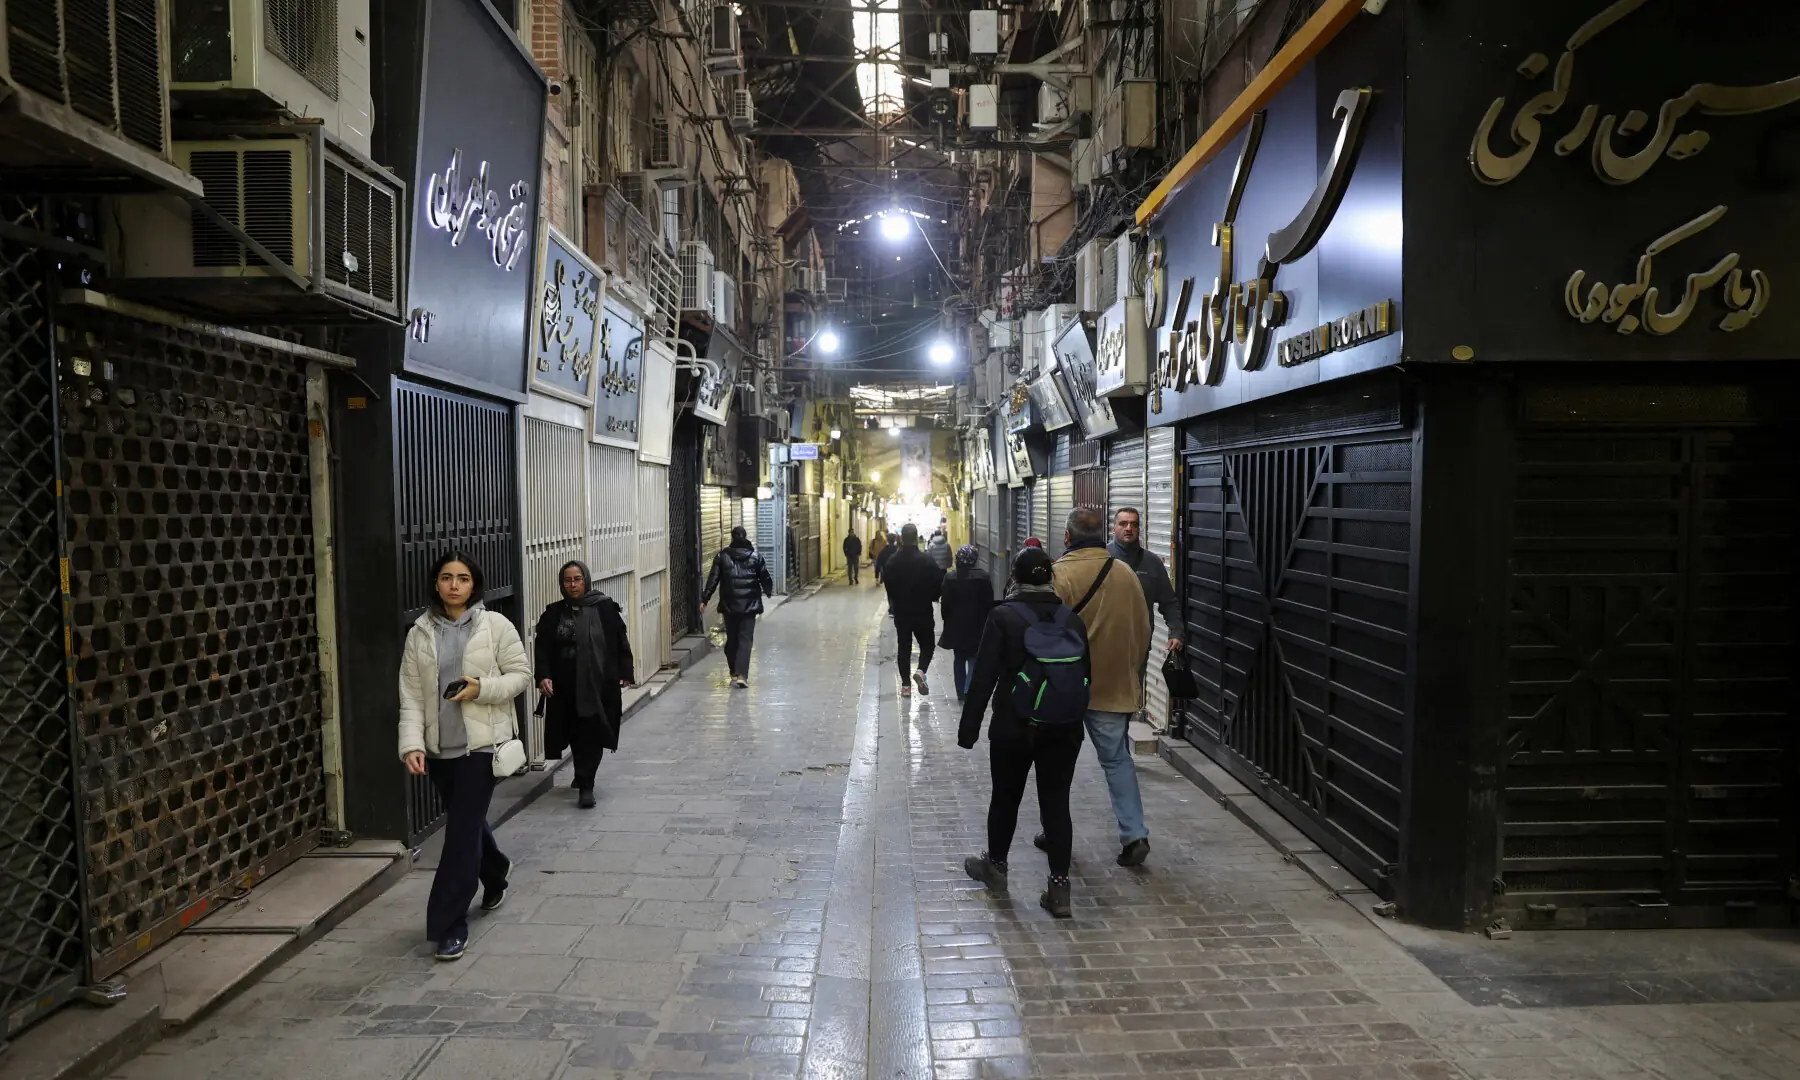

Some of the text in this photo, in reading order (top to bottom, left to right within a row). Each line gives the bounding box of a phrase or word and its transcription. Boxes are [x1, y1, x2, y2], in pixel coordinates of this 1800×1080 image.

[1592, 76, 1800, 185] سین
[1278, 298, 1393, 368] HOSEIN ROKNI
